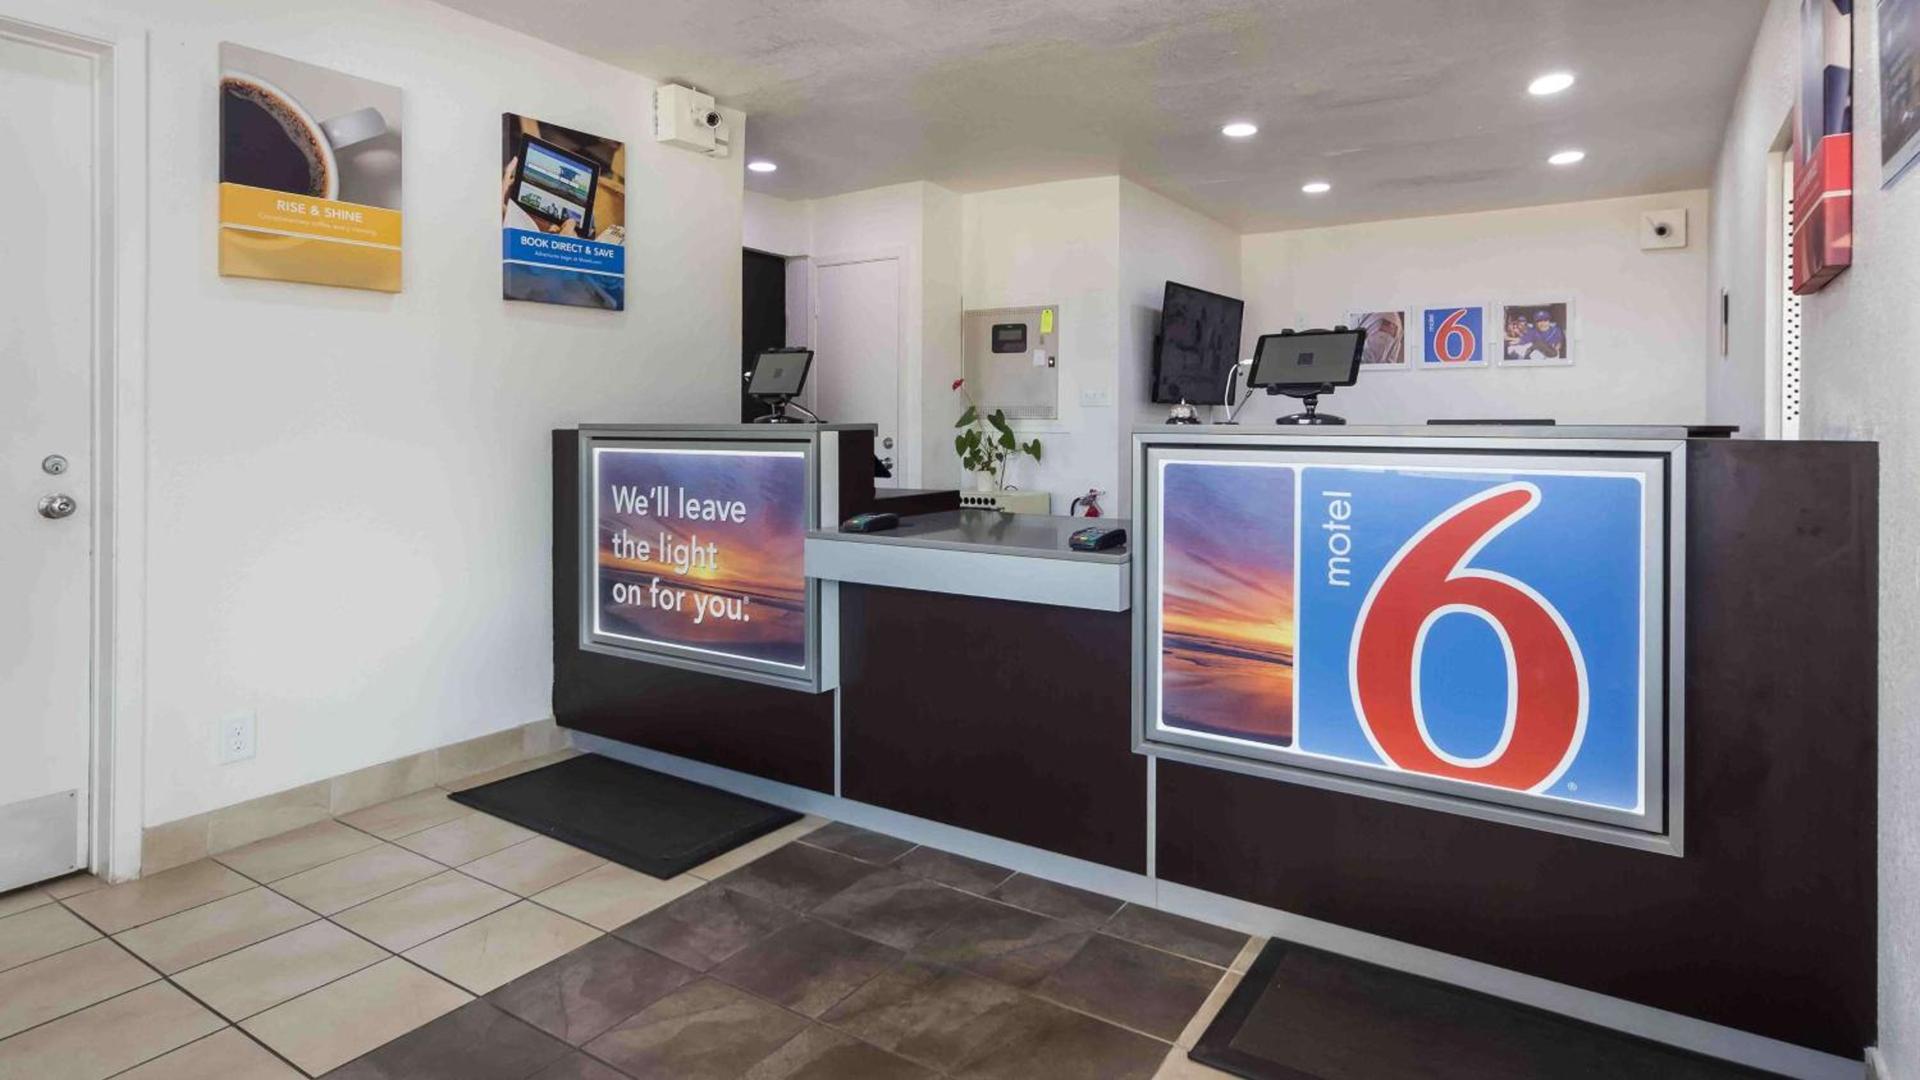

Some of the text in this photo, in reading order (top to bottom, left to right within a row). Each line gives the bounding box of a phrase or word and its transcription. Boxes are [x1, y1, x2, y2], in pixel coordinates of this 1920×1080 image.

[277, 199, 363, 223] RISE & SHINE
[520, 235, 549, 249] BOOK
[551, 240, 582, 253] DIRECT
[584, 246, 592, 255] &
[593, 247, 614, 258] SAVE
[1433, 308, 1476, 363] 6
[612, 485, 747, 523] We'll leave
[611, 528, 718, 575] the light
[612, 581, 641, 606] on
[649, 577, 685, 612] for
[1322, 480, 1590, 796] motel 6
